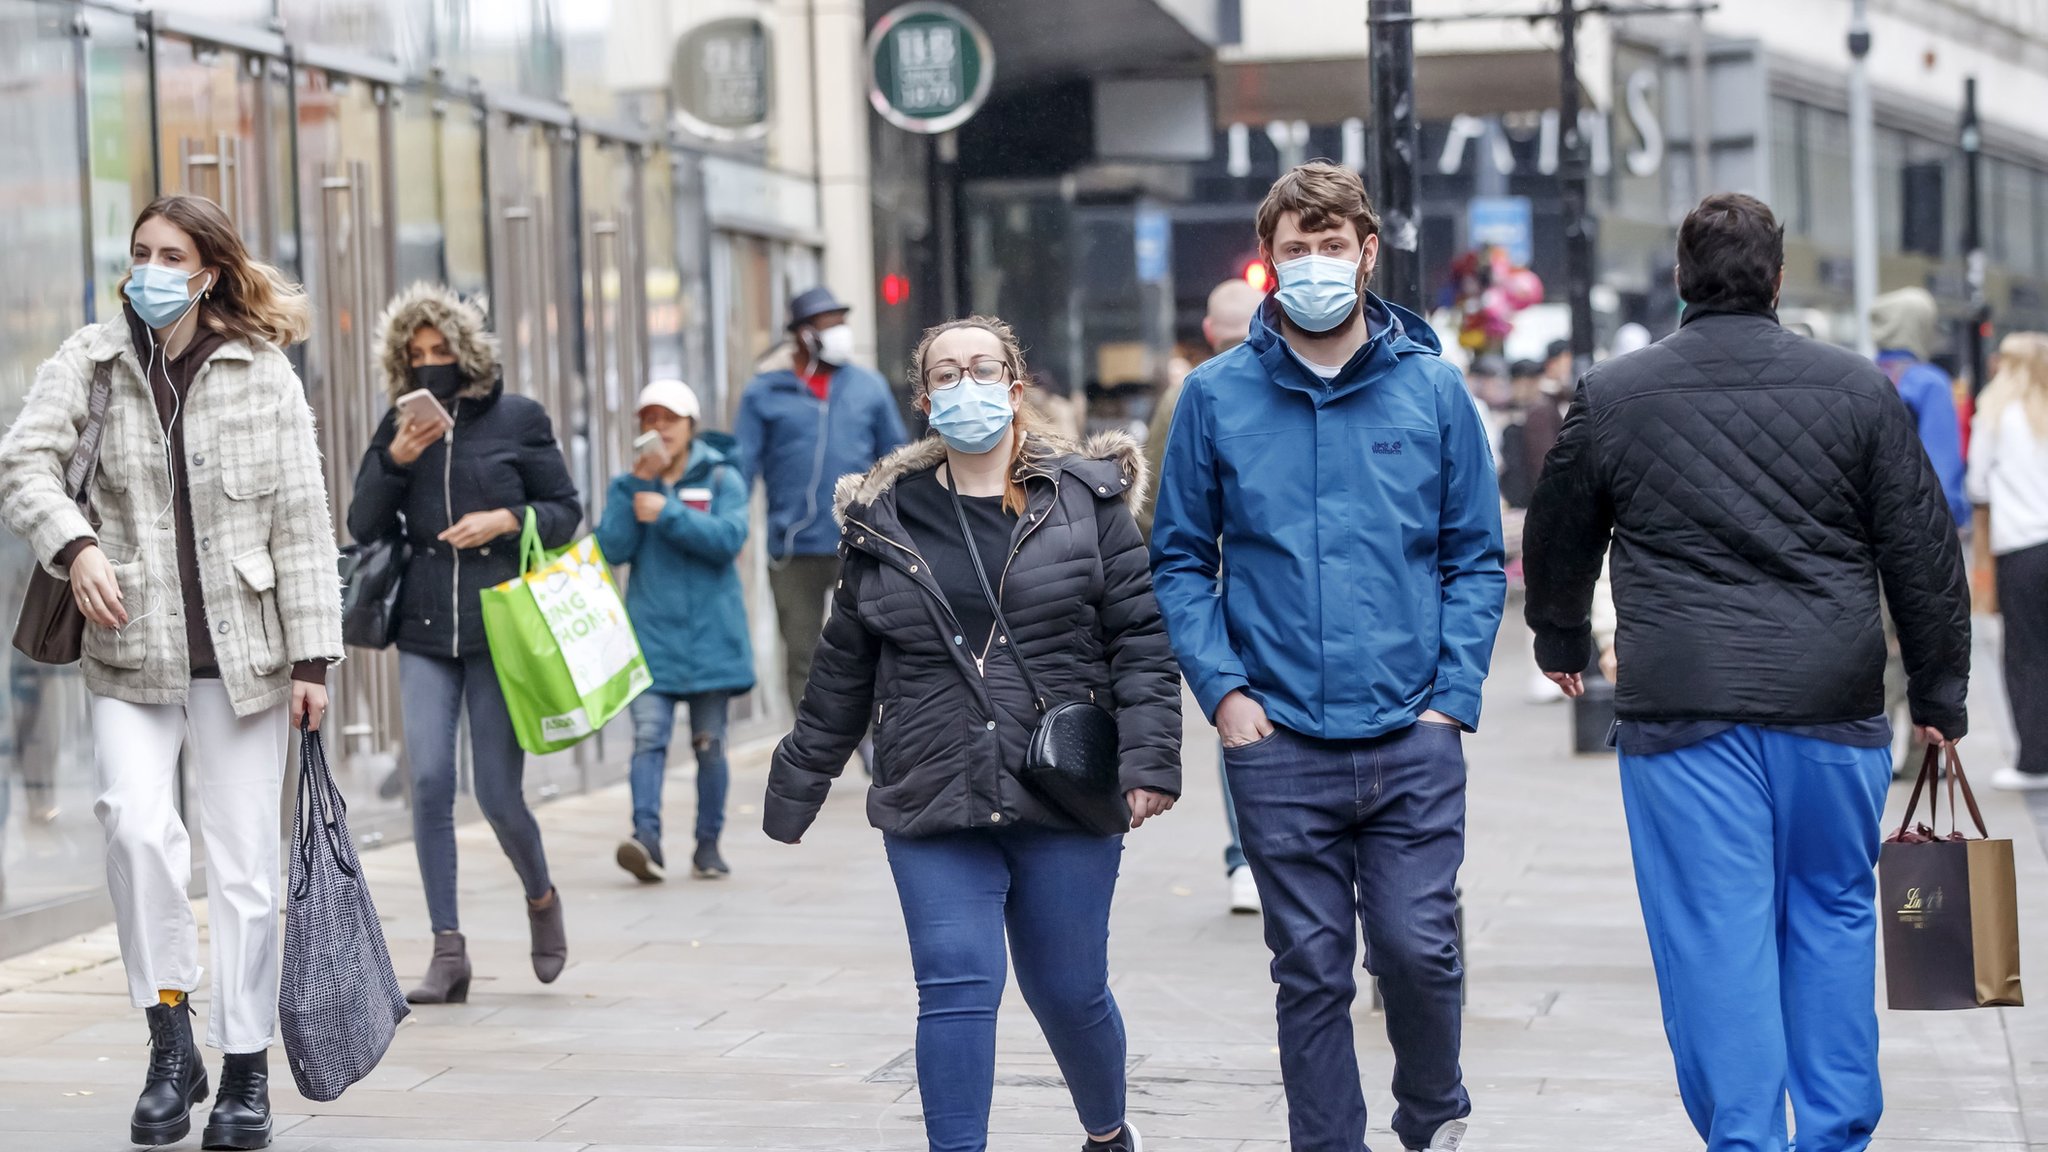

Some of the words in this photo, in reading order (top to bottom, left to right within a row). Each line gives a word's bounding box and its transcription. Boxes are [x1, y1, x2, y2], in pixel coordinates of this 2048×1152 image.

[89, 380, 109, 417] NIKE
[80, 418, 100, 453] NIKE
[67, 454, 88, 489] NIKE
